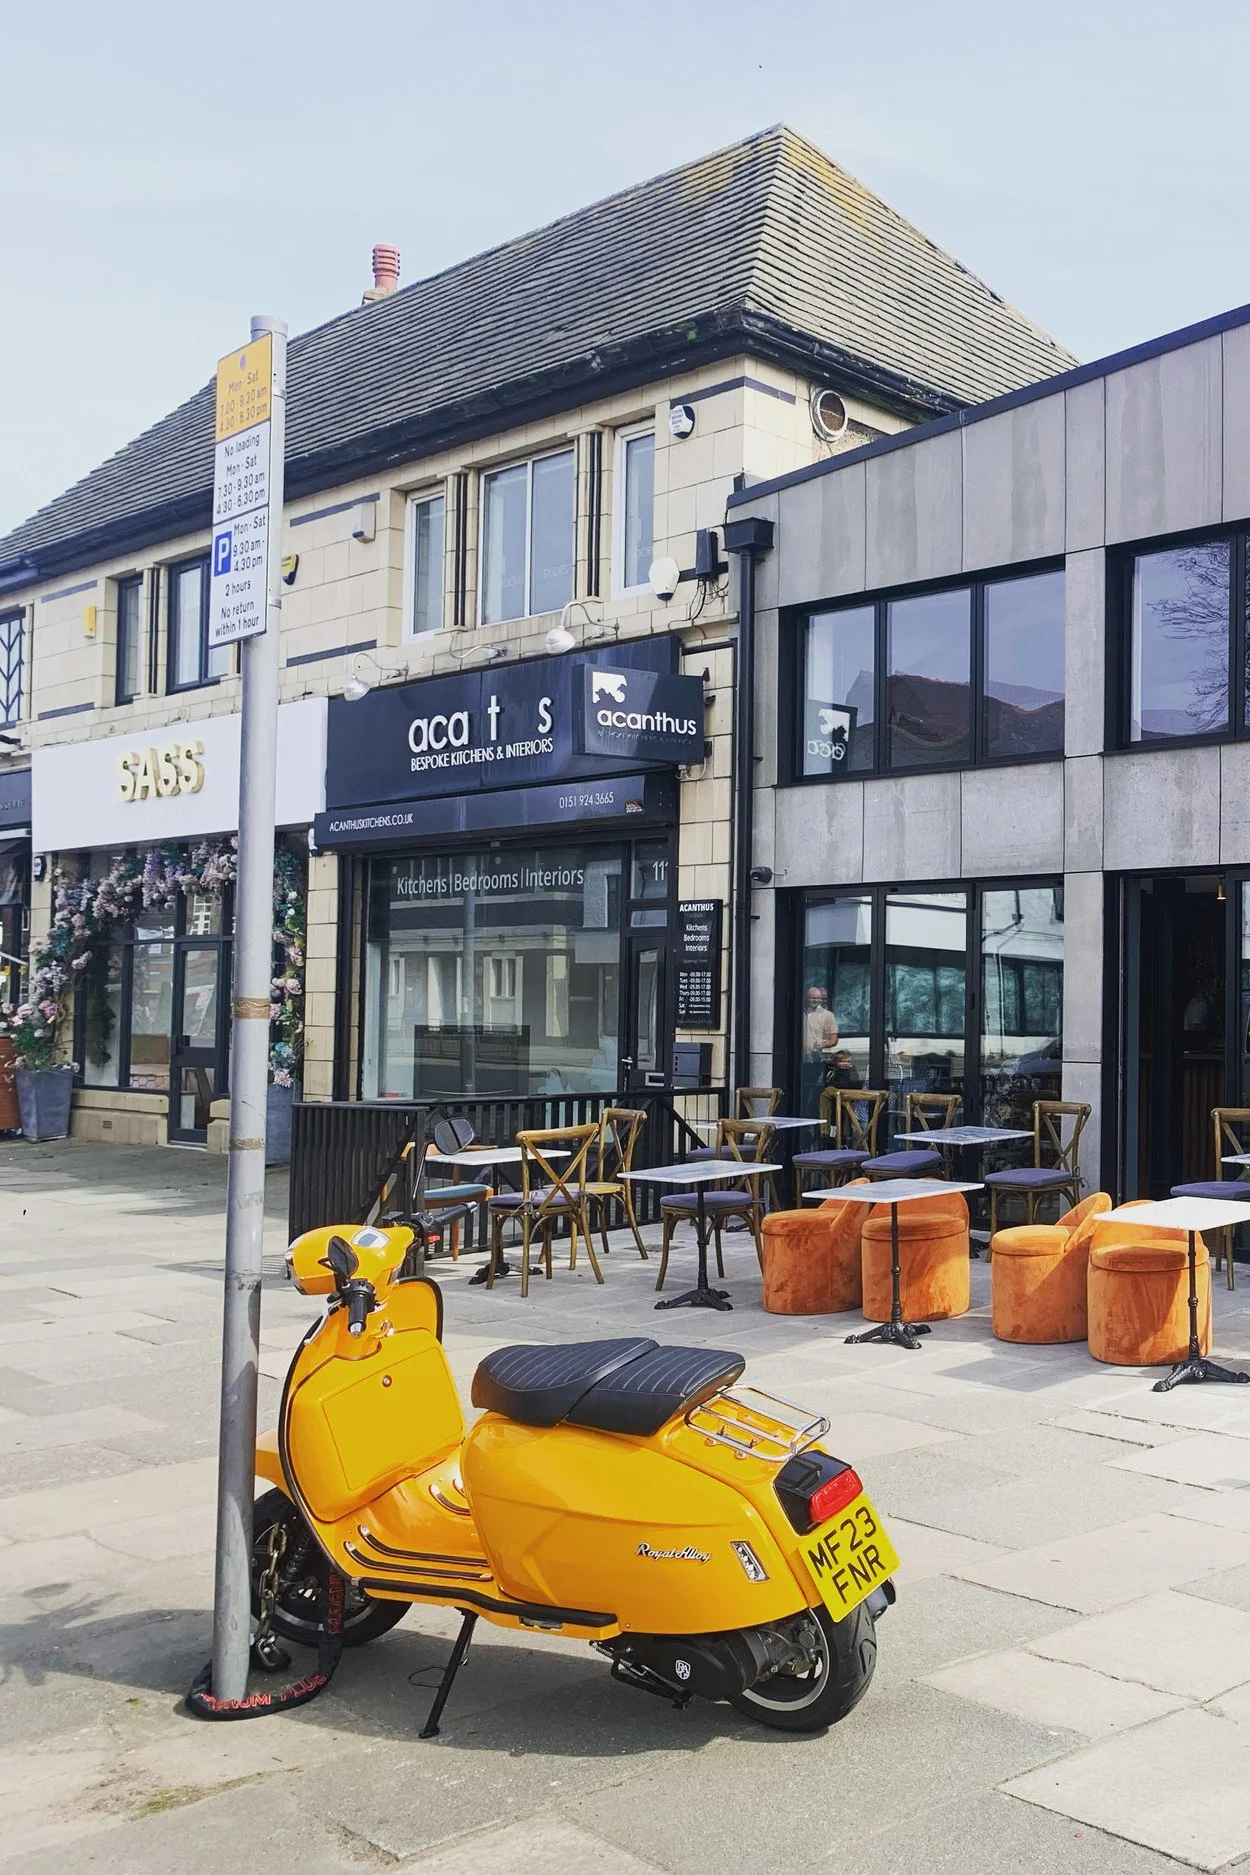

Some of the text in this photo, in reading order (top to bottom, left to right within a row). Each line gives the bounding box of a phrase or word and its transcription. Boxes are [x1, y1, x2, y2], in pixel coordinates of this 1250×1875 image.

[228, 380, 242, 395] Mon
[247, 369, 259, 385] Sat
[257, 386, 267, 398] am
[225, 434, 260, 458] No loading
[226, 464, 240, 478] Mon
[245, 453, 257, 469] Sat
[217, 482, 232, 499] 7.30
[237, 473, 253, 491] 9.30
[255, 472, 265, 484] am
[216, 498, 232, 515] 4.30
[237, 489, 253, 508] 6.30
[255, 488, 265, 503] pm
[233, 523, 248, 537] Mon
[253, 515, 266, 529] Sat
[233, 540, 250, 557] 9.30
[250, 539, 261, 551] am
[233, 555, 263, 573] 4.30 pm
[225, 579, 251, 597] 2 hours
[220, 600, 254, 619] No return
[215, 622, 236, 638] within
[243, 615, 259, 630] hour
[596, 709, 697, 736] acanthus
[410, 737, 554, 772] BESPOKE KITCHENS & INTERIORS
[116, 739, 205, 803] SASS
[559, 791, 614, 808] 0151 924 3665
[329, 812, 414, 832] ACANTHUSKITCHENS.CO.UK
[397, 865, 584, 895] Kitchens Bedrooms Interiors
[679, 903, 714, 912] ACANTHUS
[683, 933, 710, 942] Bedrooms
[685, 923, 708, 932] Kitchens
[685, 944, 708, 952] Interiors
[636, 1541, 712, 1564] Royal Alloy
[807, 1505, 877, 1578] MF23
[831, 1544, 887, 1605] FNR
